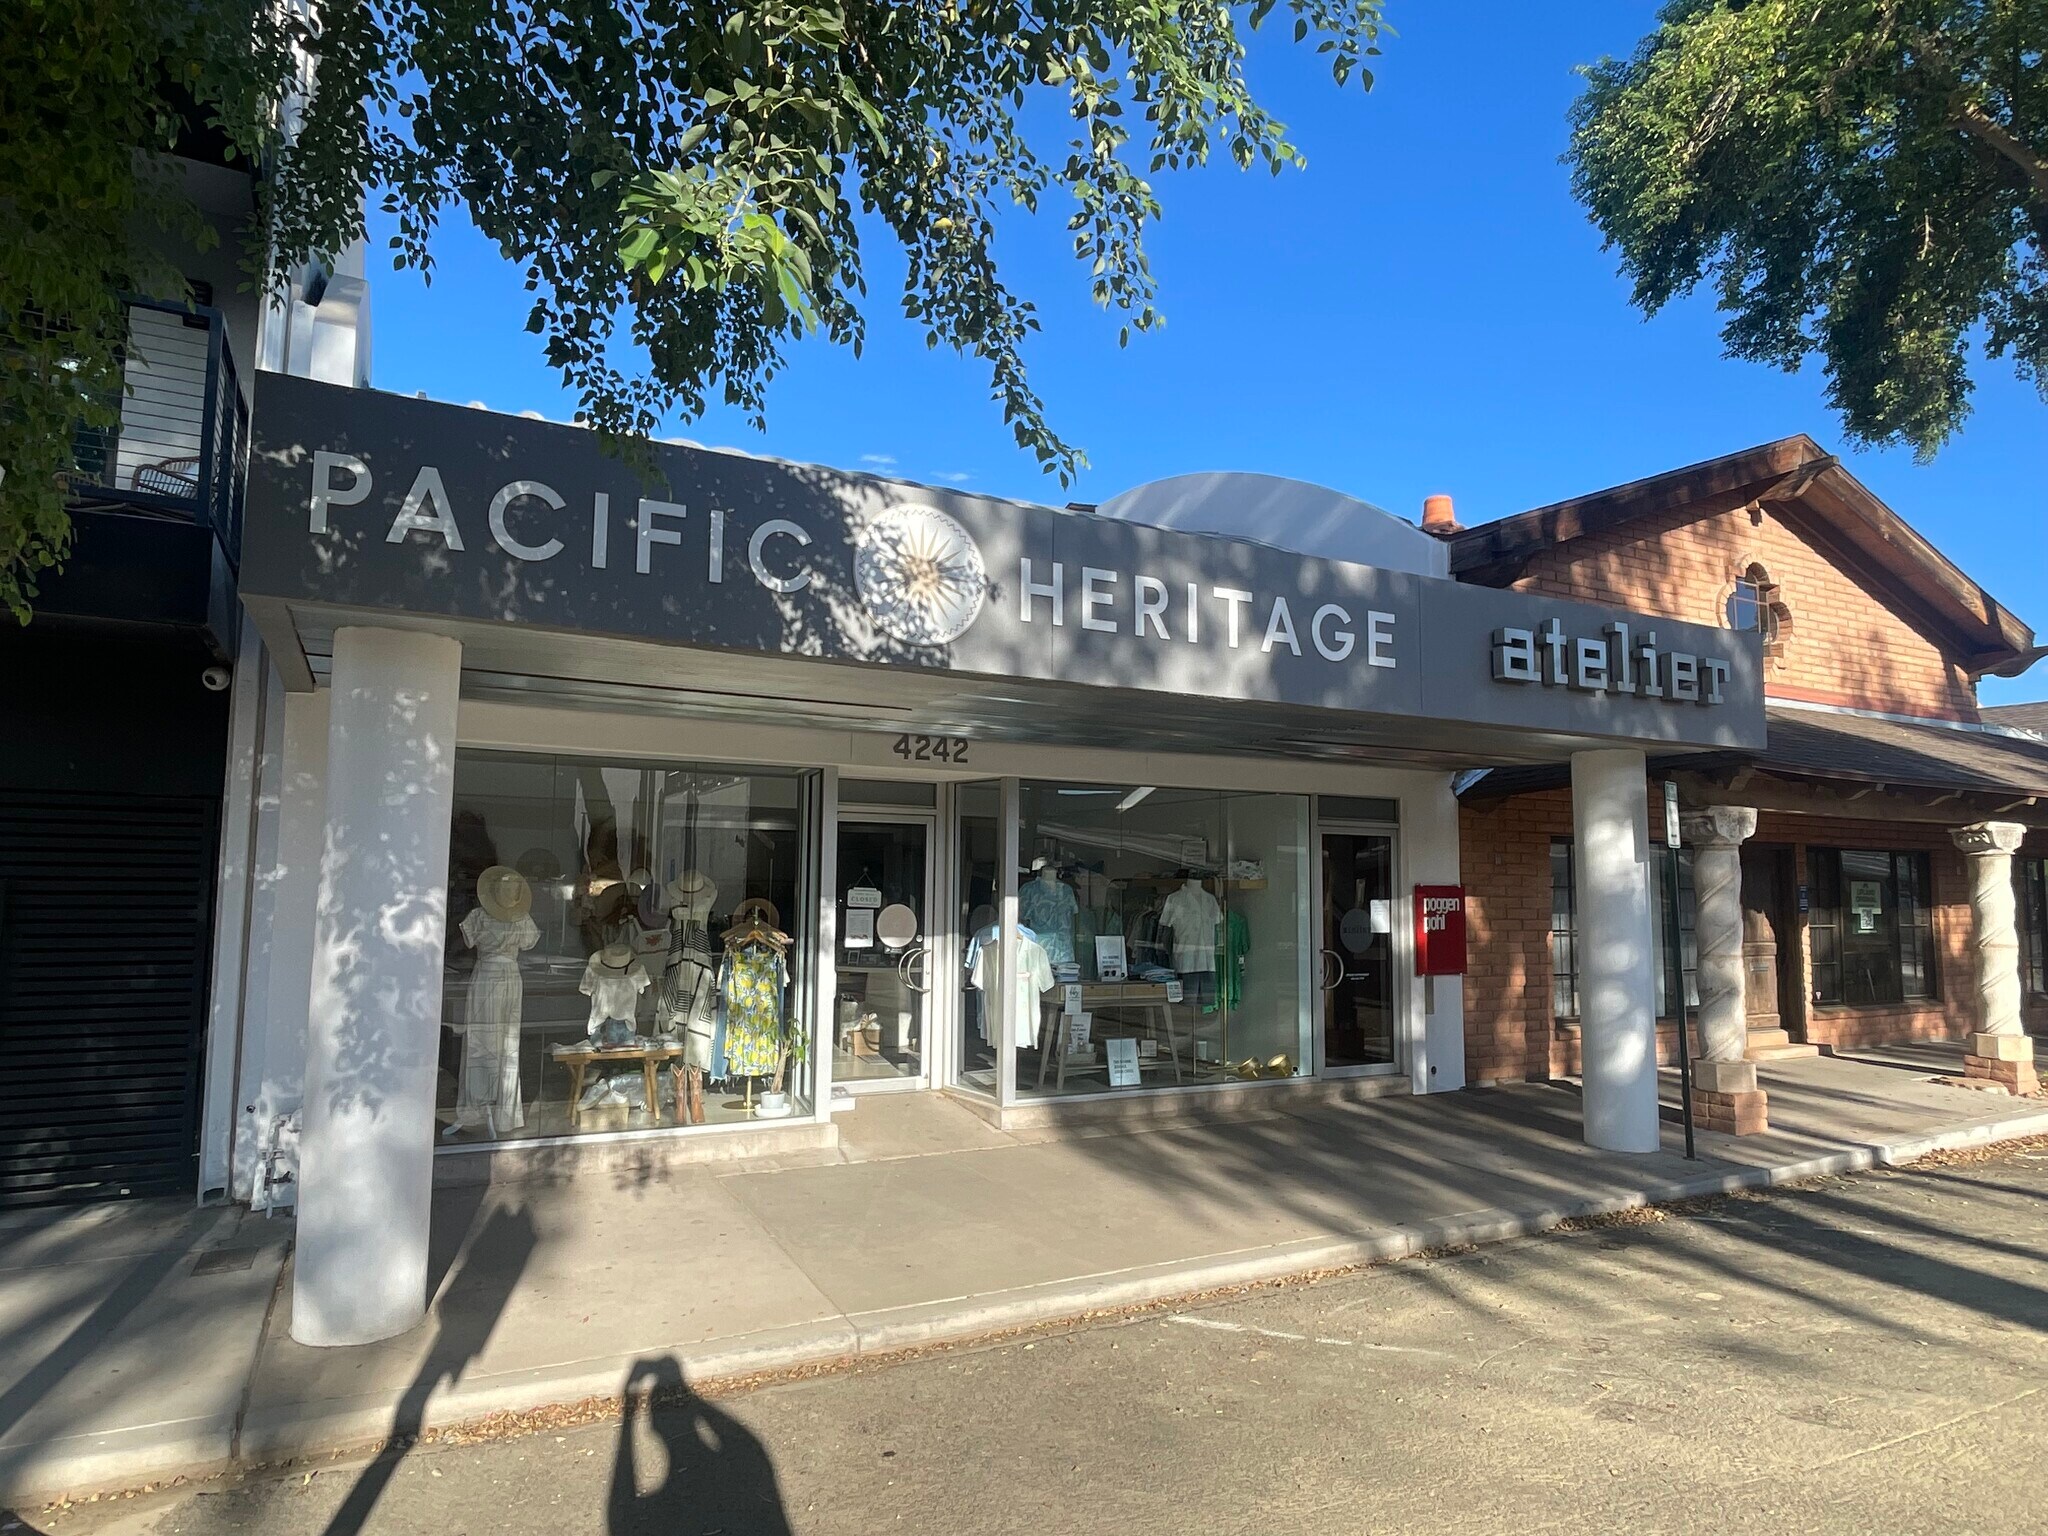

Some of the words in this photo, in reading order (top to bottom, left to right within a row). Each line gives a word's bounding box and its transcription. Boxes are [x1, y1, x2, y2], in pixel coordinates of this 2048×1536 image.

[309, 450, 813, 594] PACIFIC
[1019, 557, 1397, 669] HERITAGE
[1492, 618, 1731, 706] atelier
[893, 733, 968, 763] 4242
[1424, 898, 1460, 914] poggen
[1424, 915, 1446, 934] pohl
